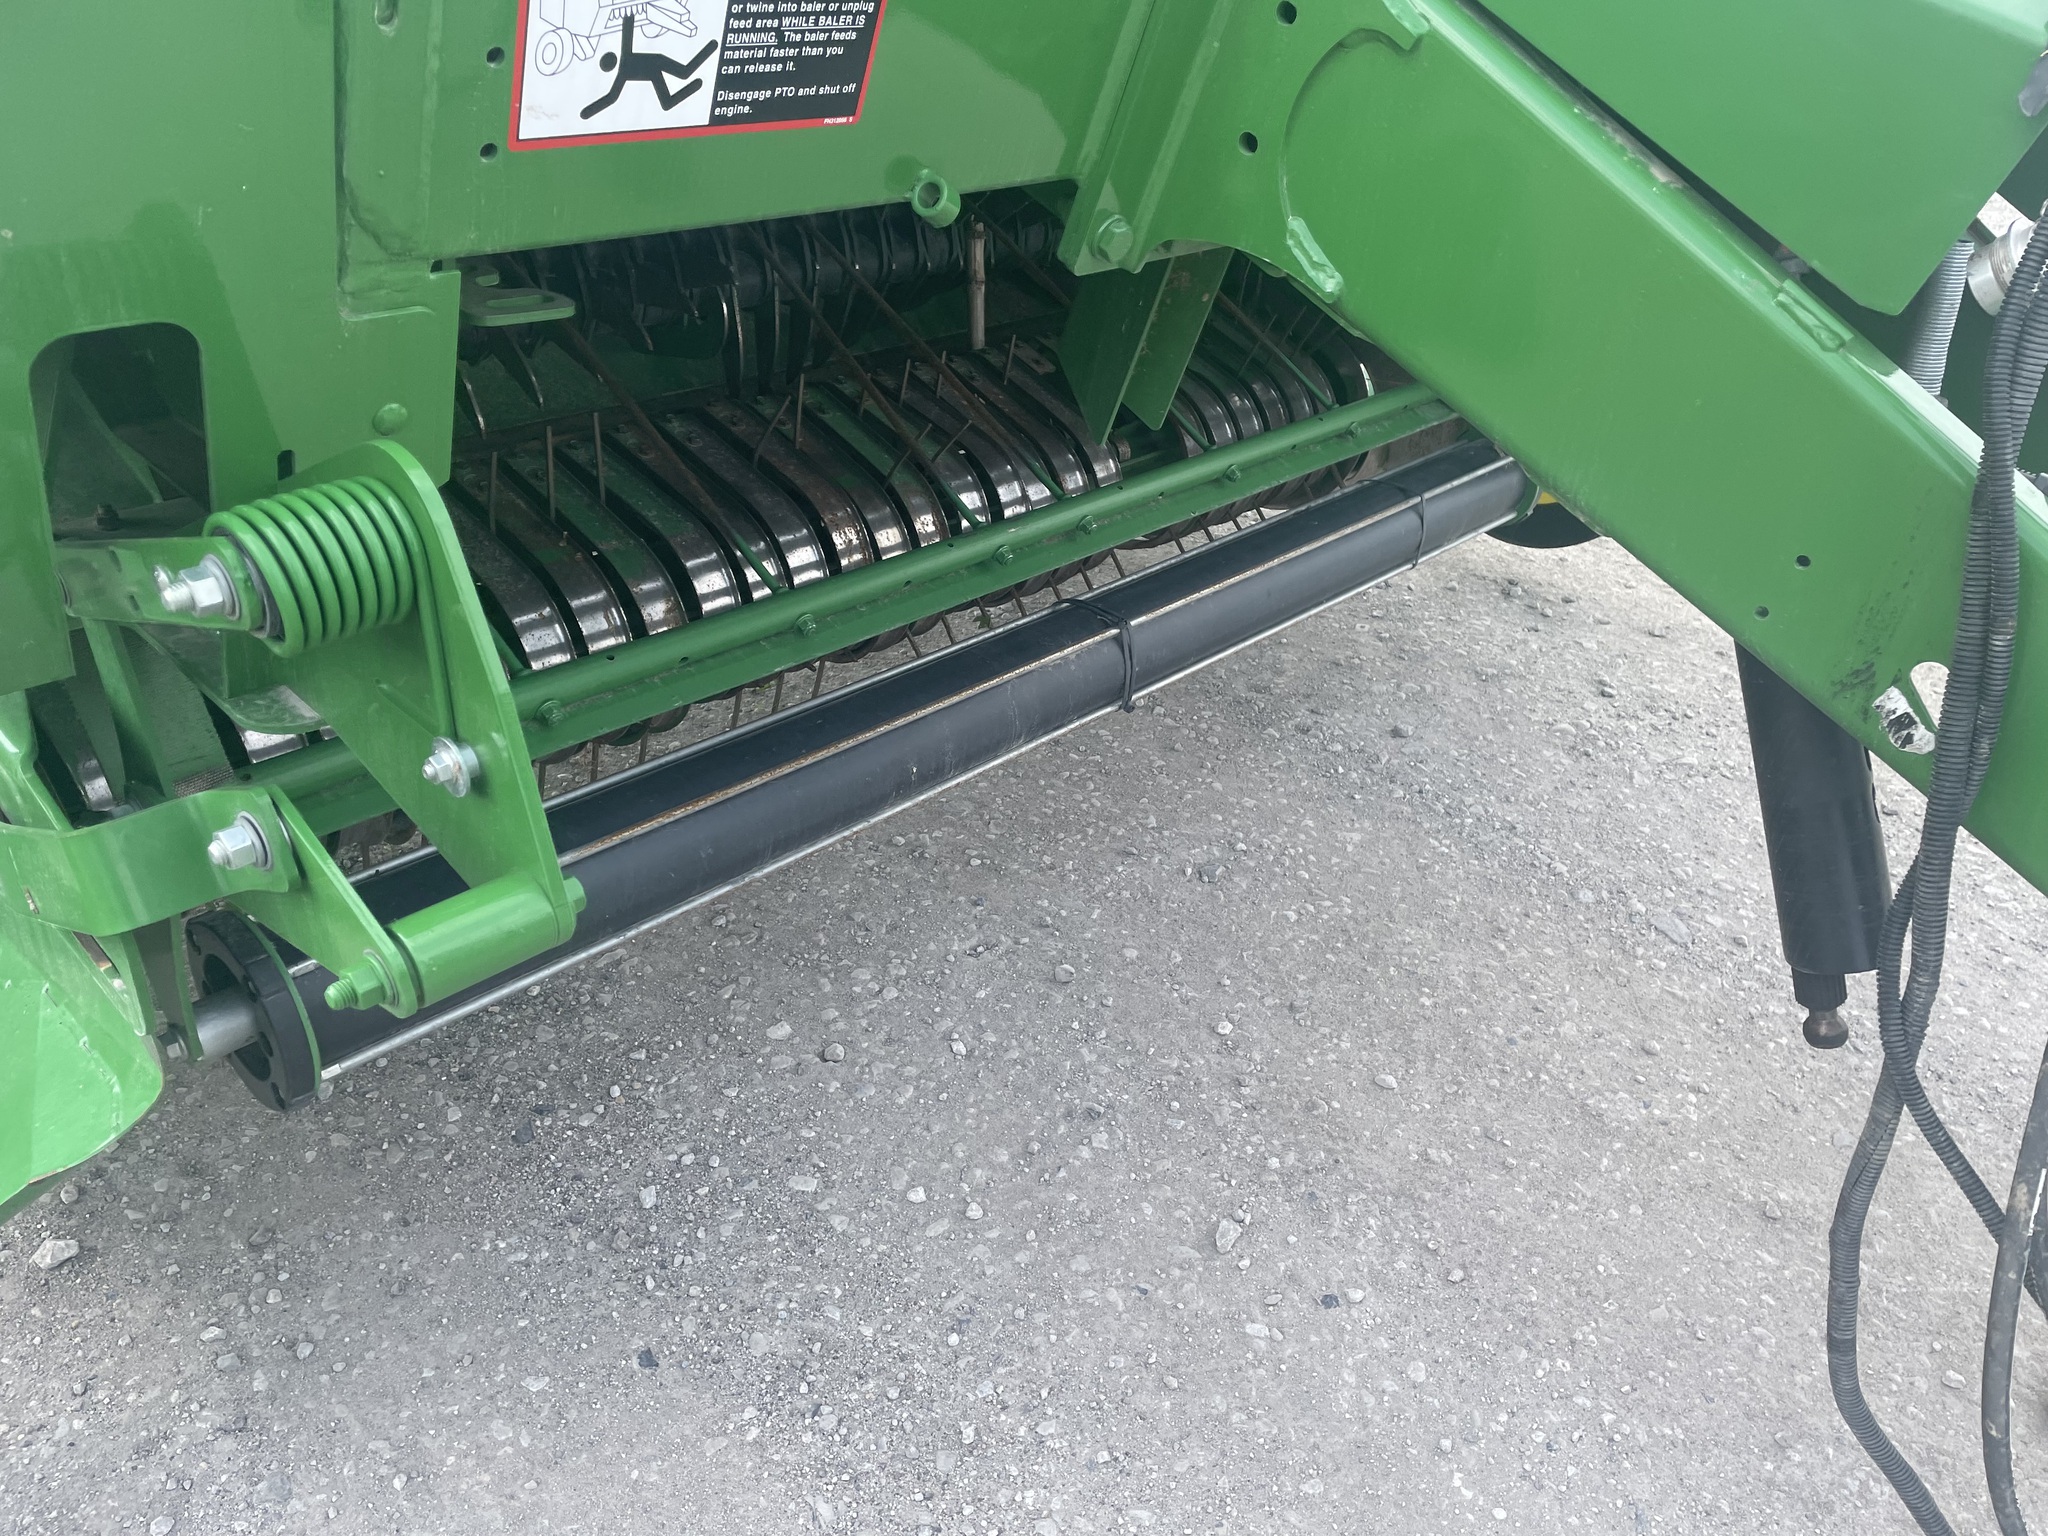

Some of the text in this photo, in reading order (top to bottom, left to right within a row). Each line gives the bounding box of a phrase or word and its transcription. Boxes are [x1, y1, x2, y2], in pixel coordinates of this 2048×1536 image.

[731, 1, 874, 13] or twine into baler or unplug
[729, 15, 865, 29] feed area WHILE BALER IS
[726, 30, 857, 44] RUNNING. The baler feeds
[724, 46, 844, 59] material faster than you
[721, 61, 796, 75] can release it.
[717, 83, 857, 102] Disengage PTO and shut off
[714, 104, 753, 117] engine.
